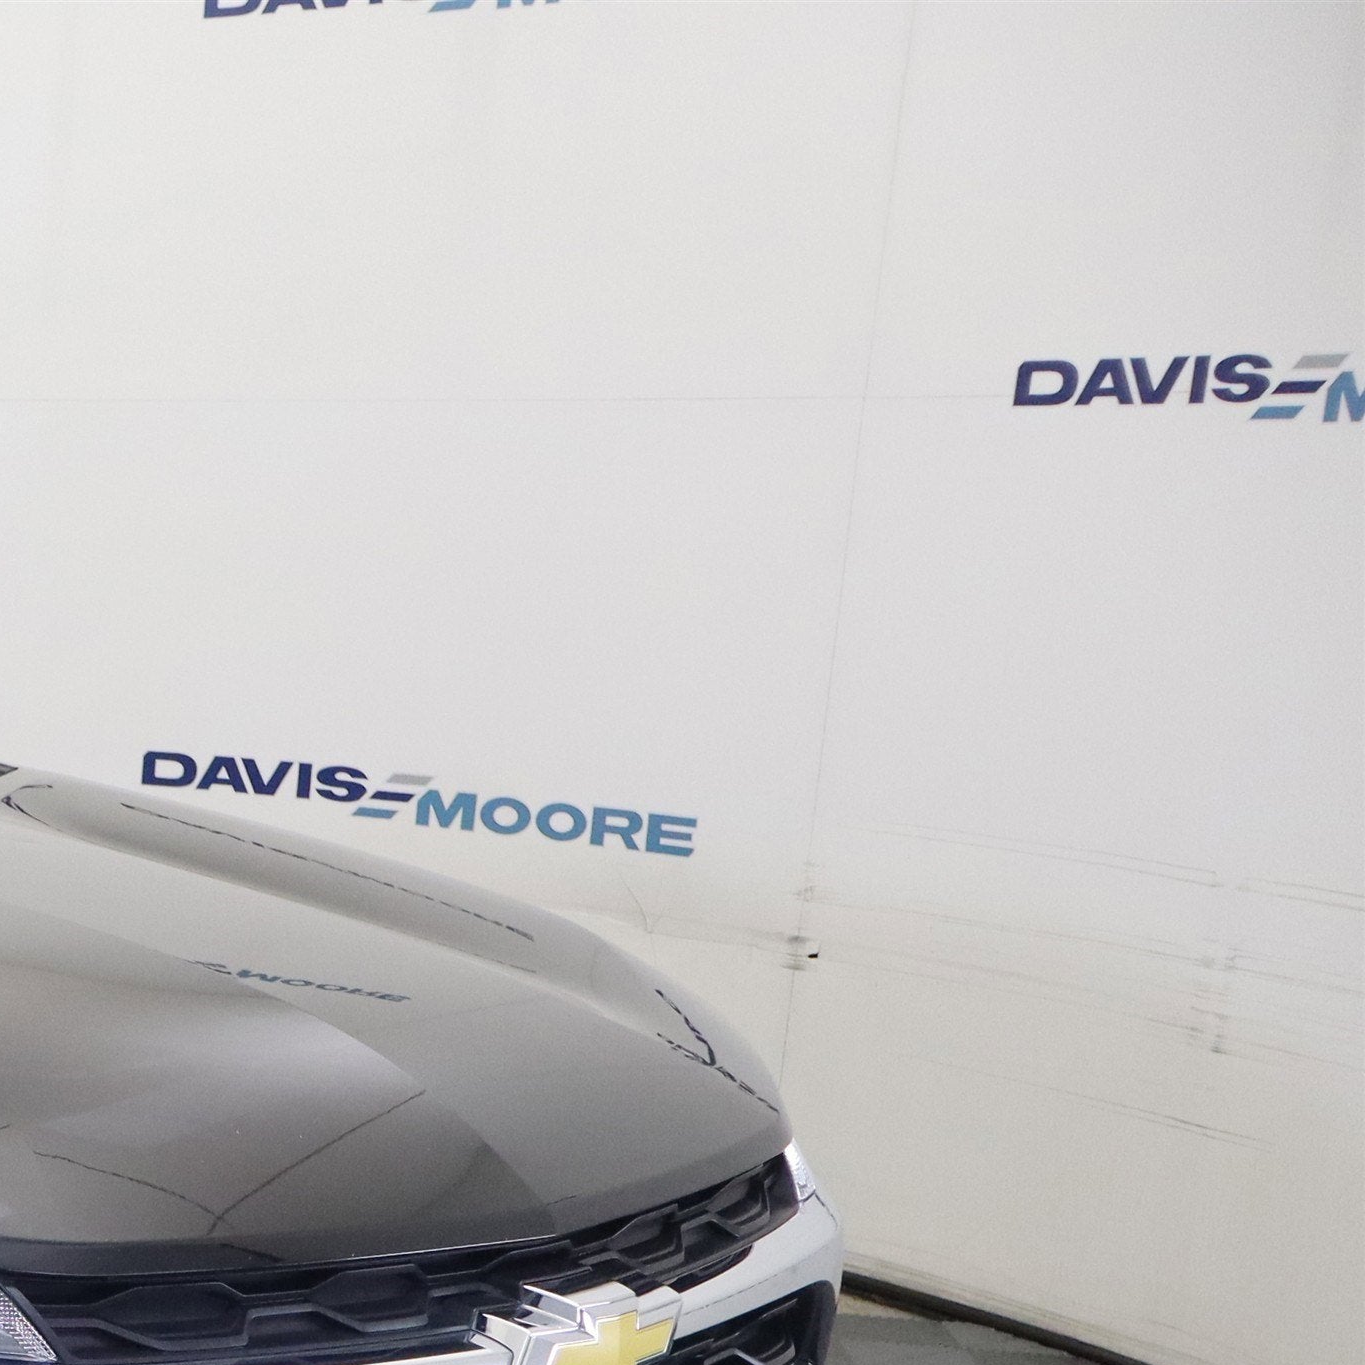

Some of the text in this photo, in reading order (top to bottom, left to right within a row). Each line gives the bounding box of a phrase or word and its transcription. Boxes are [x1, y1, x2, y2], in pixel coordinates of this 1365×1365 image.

[1012, 353, 1274, 407] DAVIS
[142, 750, 699, 859] DAVIS MOORE
